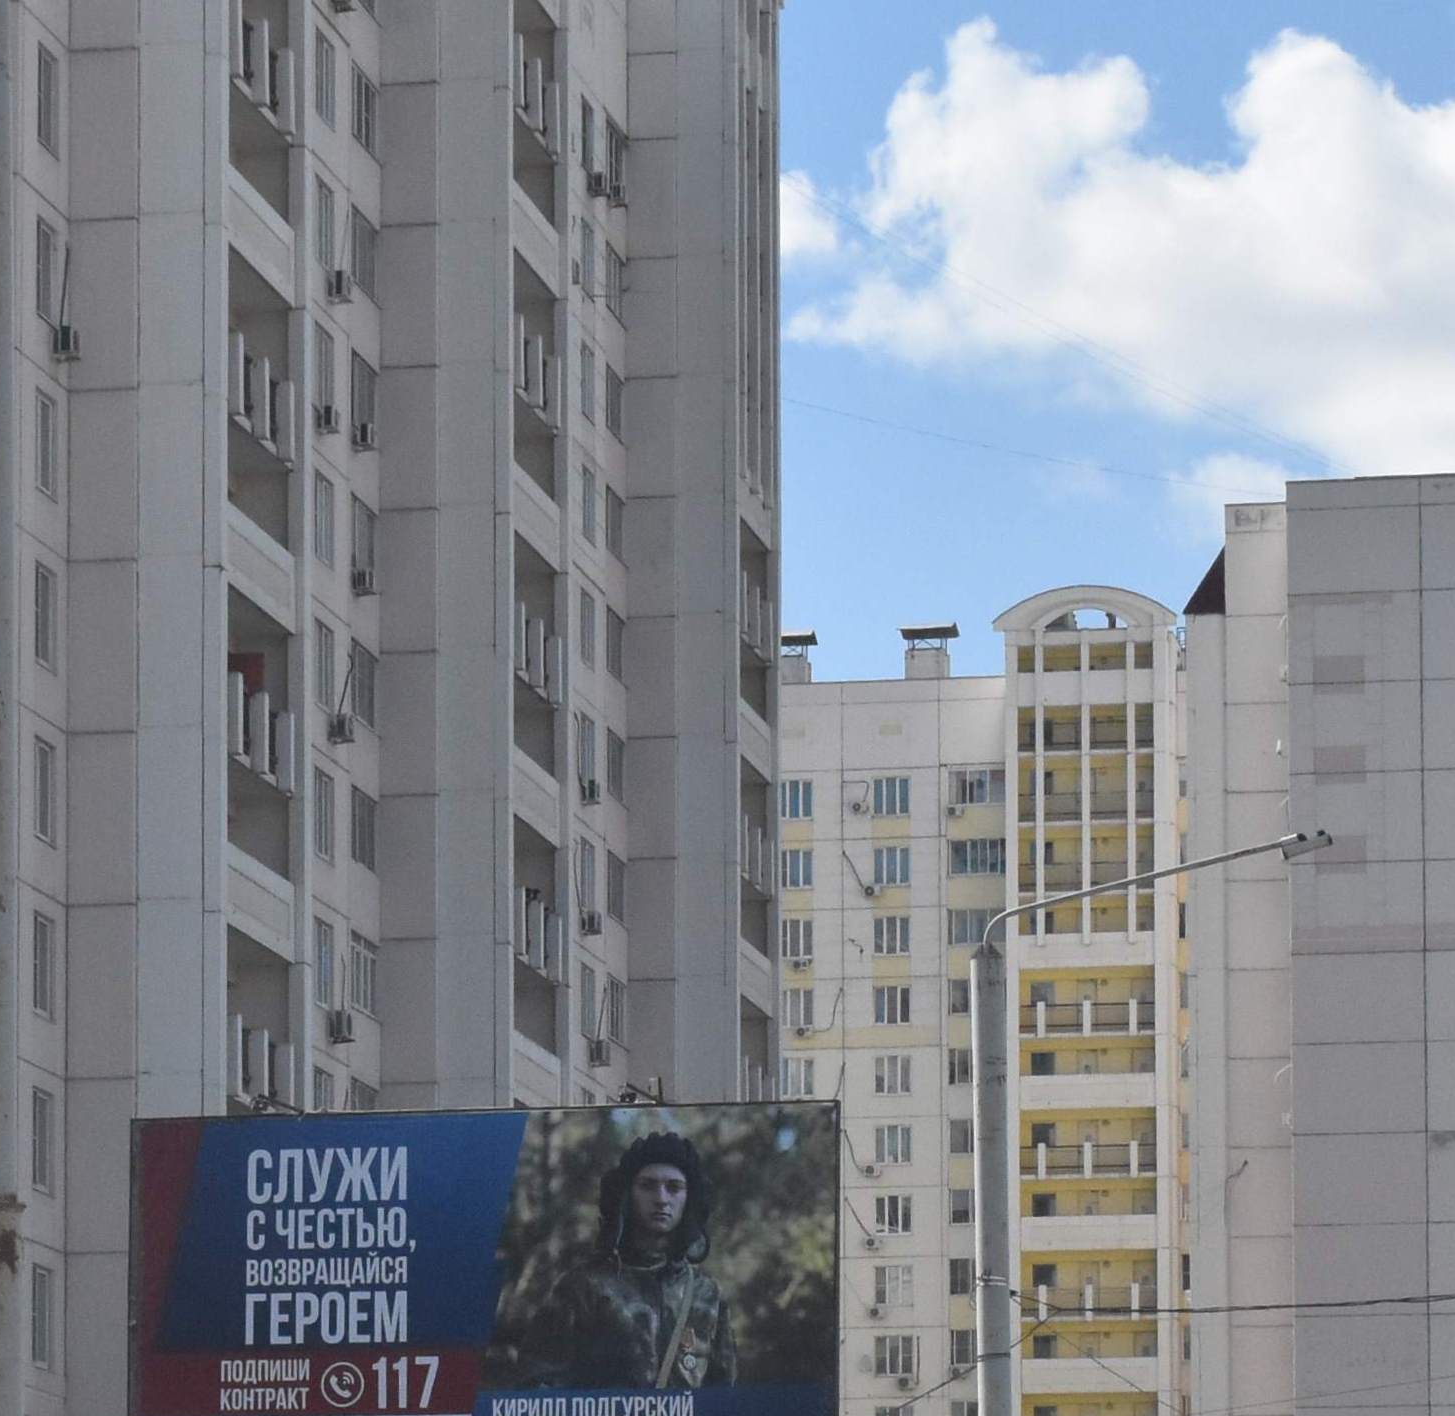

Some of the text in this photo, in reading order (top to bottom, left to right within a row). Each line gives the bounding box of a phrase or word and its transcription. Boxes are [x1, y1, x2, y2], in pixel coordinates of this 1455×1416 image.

[247, 1146, 408, 1204] СЛУЖИ
[246, 1206, 417, 1253] С ЧЕСТЬЮ,
[246, 1252, 408, 1287] ВОЗВРАЩАЙСЯ
[245, 1290, 408, 1345] ГЕРОЕМ
[220, 1358, 310, 1384] ПОДПИШИ
[372, 1356, 439, 1409] 117
[220, 1387, 309, 1411] КОНТРАКТ
